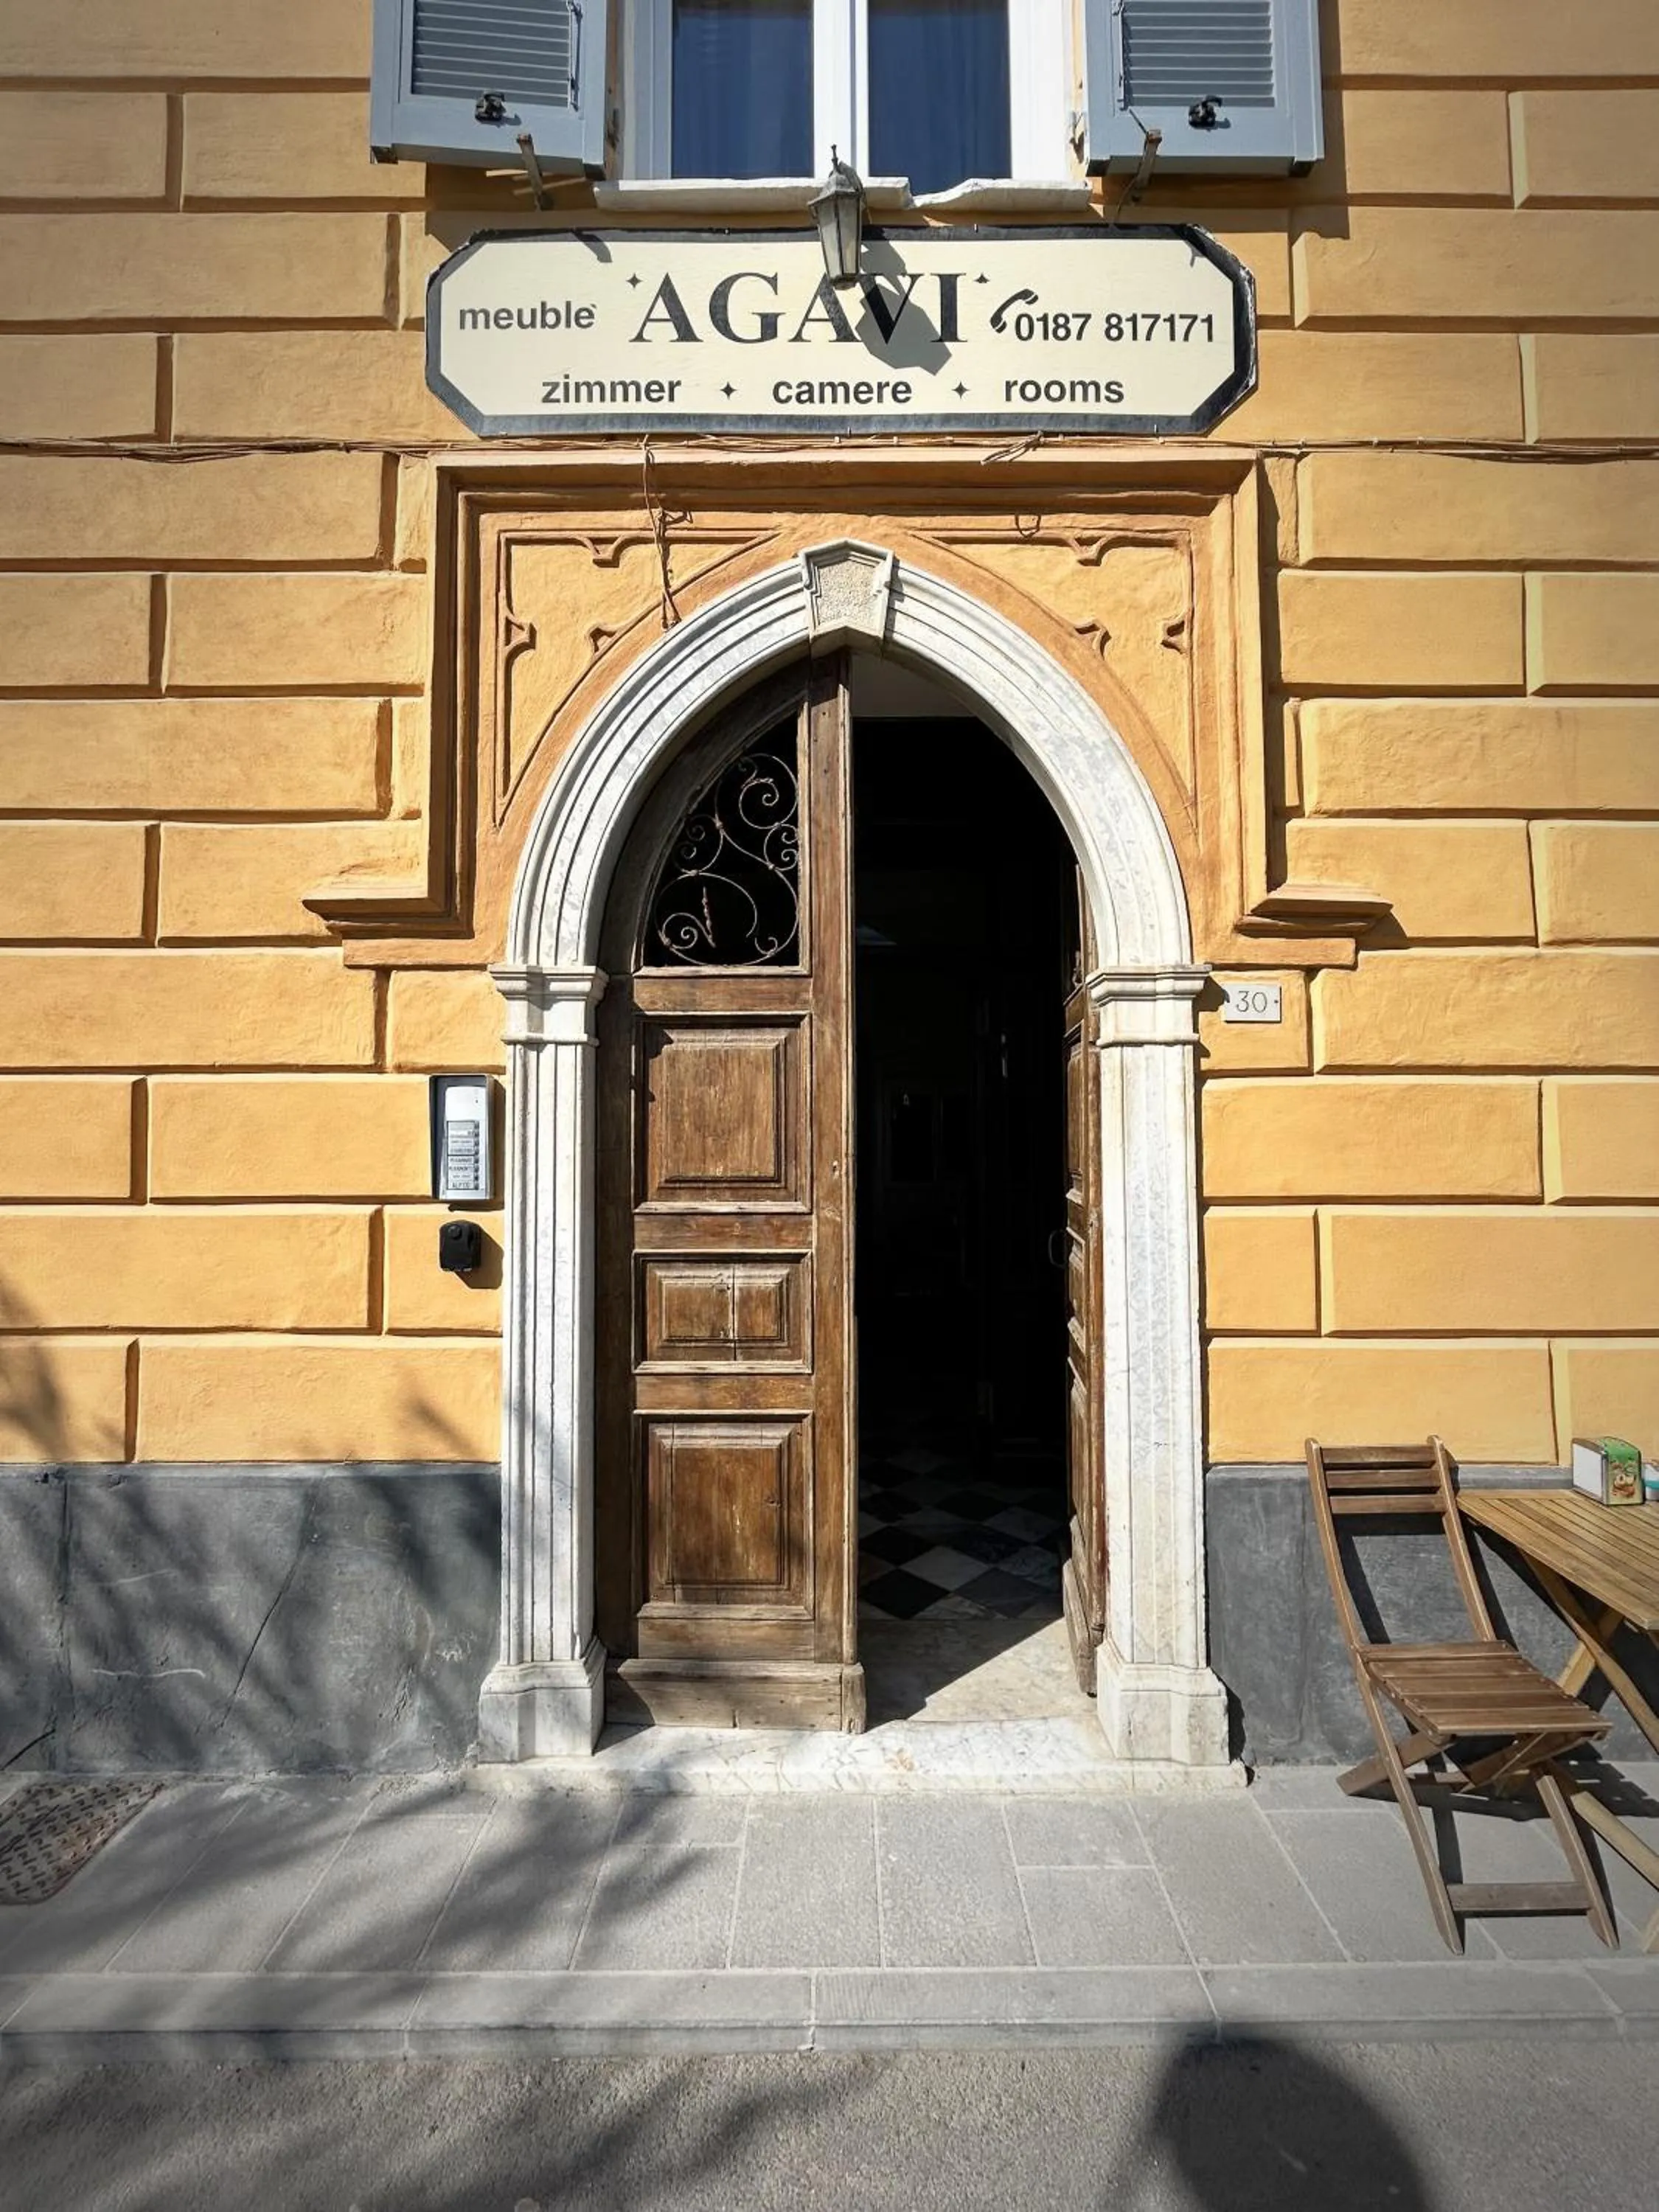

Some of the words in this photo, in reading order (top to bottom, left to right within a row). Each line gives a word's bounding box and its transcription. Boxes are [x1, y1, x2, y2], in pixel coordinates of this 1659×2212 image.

[629, 271, 968, 345] AGAVI
[1015, 313, 1092, 342] 0187
[1105, 313, 1214, 342] 817171
[541, 374, 682, 404] zimmer
[772, 378, 913, 406] camere
[1004, 379, 1124, 404] rooms
[1236, 990, 1267, 1013] 30
